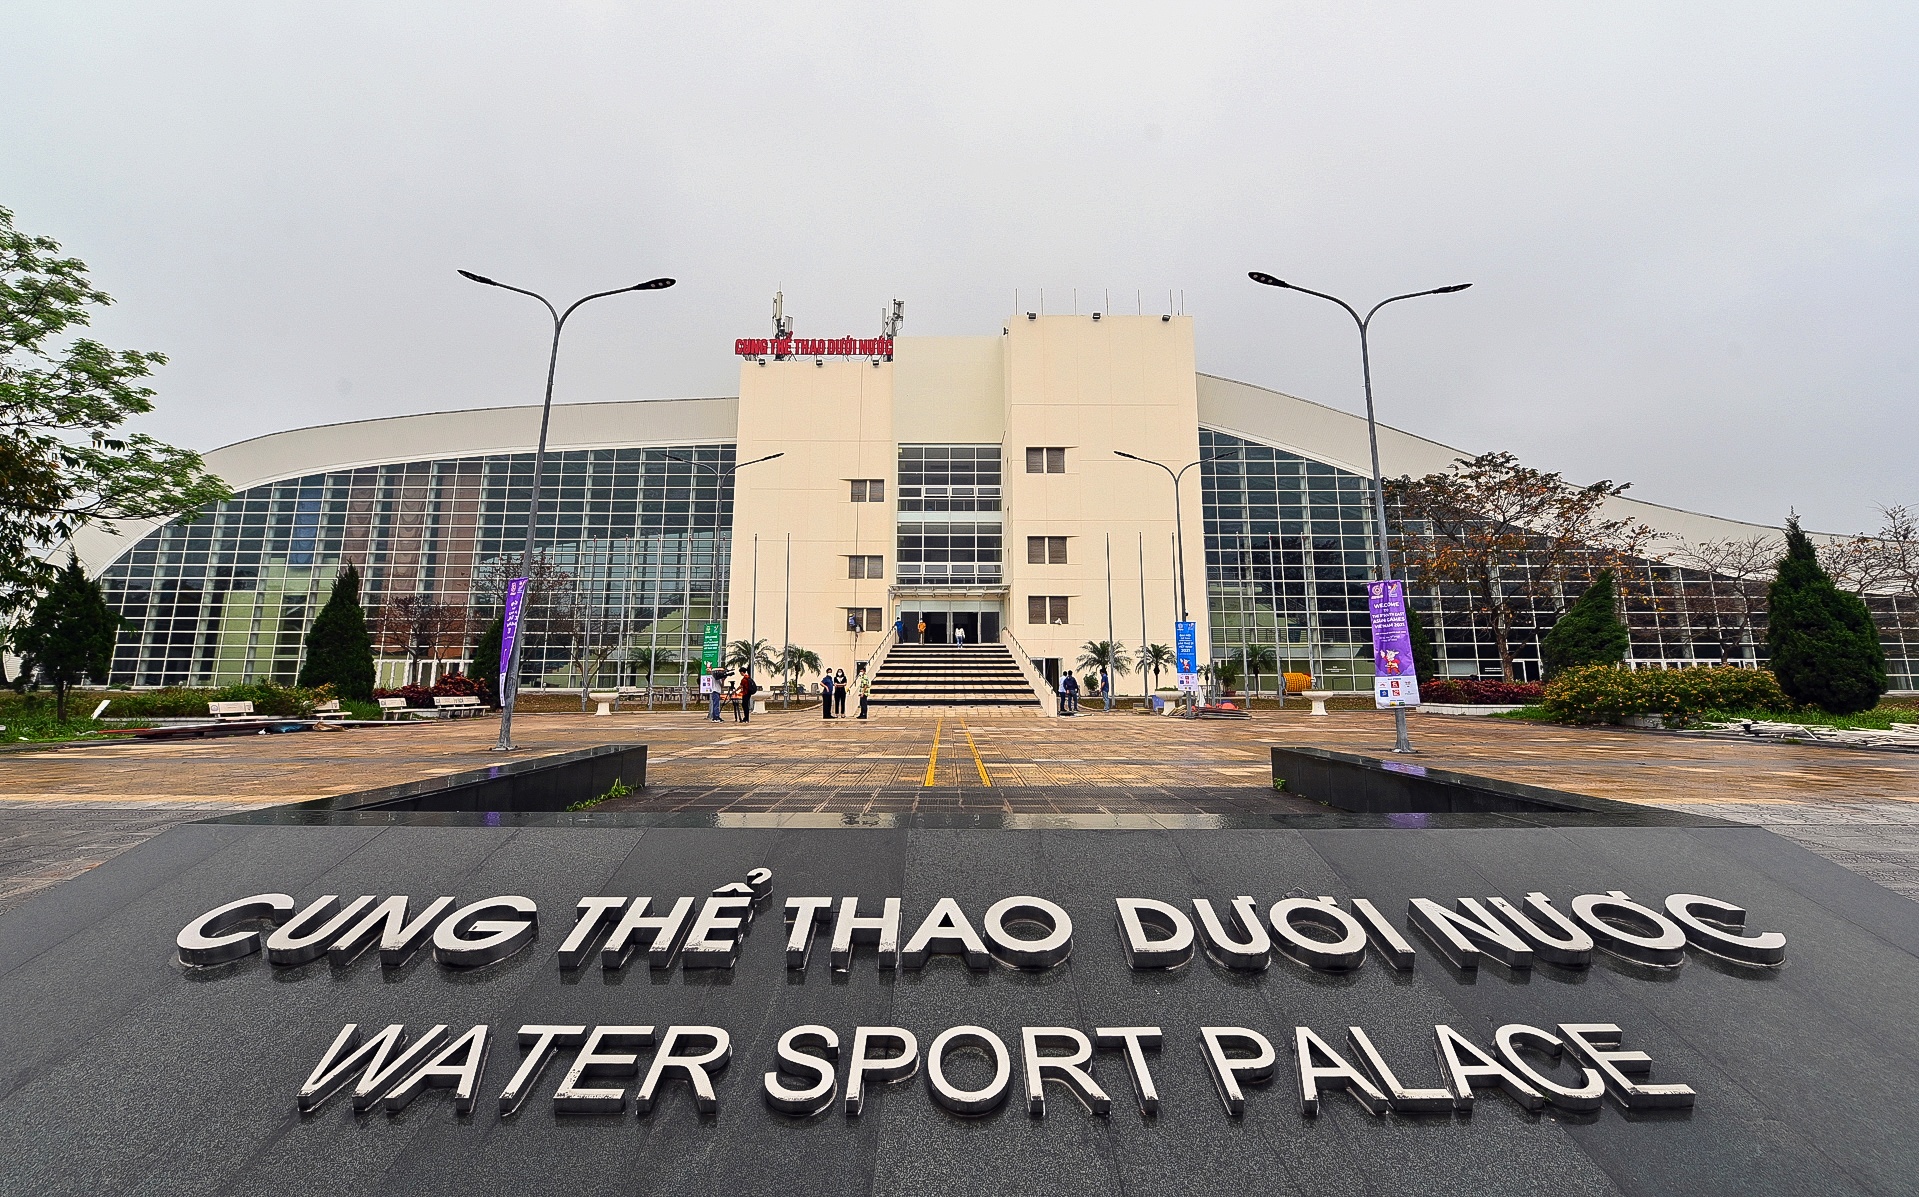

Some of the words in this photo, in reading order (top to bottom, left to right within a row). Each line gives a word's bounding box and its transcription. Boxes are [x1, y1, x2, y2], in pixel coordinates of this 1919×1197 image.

[735, 338, 768, 355] CUNG
[794, 338, 826, 355] THAO
[175, 893, 538, 964] CUNG
[558, 868, 774, 966] THỂ
[784, 895, 1074, 970] THAO
[297, 1023, 732, 1115] WATER
[764, 1025, 1163, 1116] SPORT
[1200, 1023, 1696, 1115] PALACE
